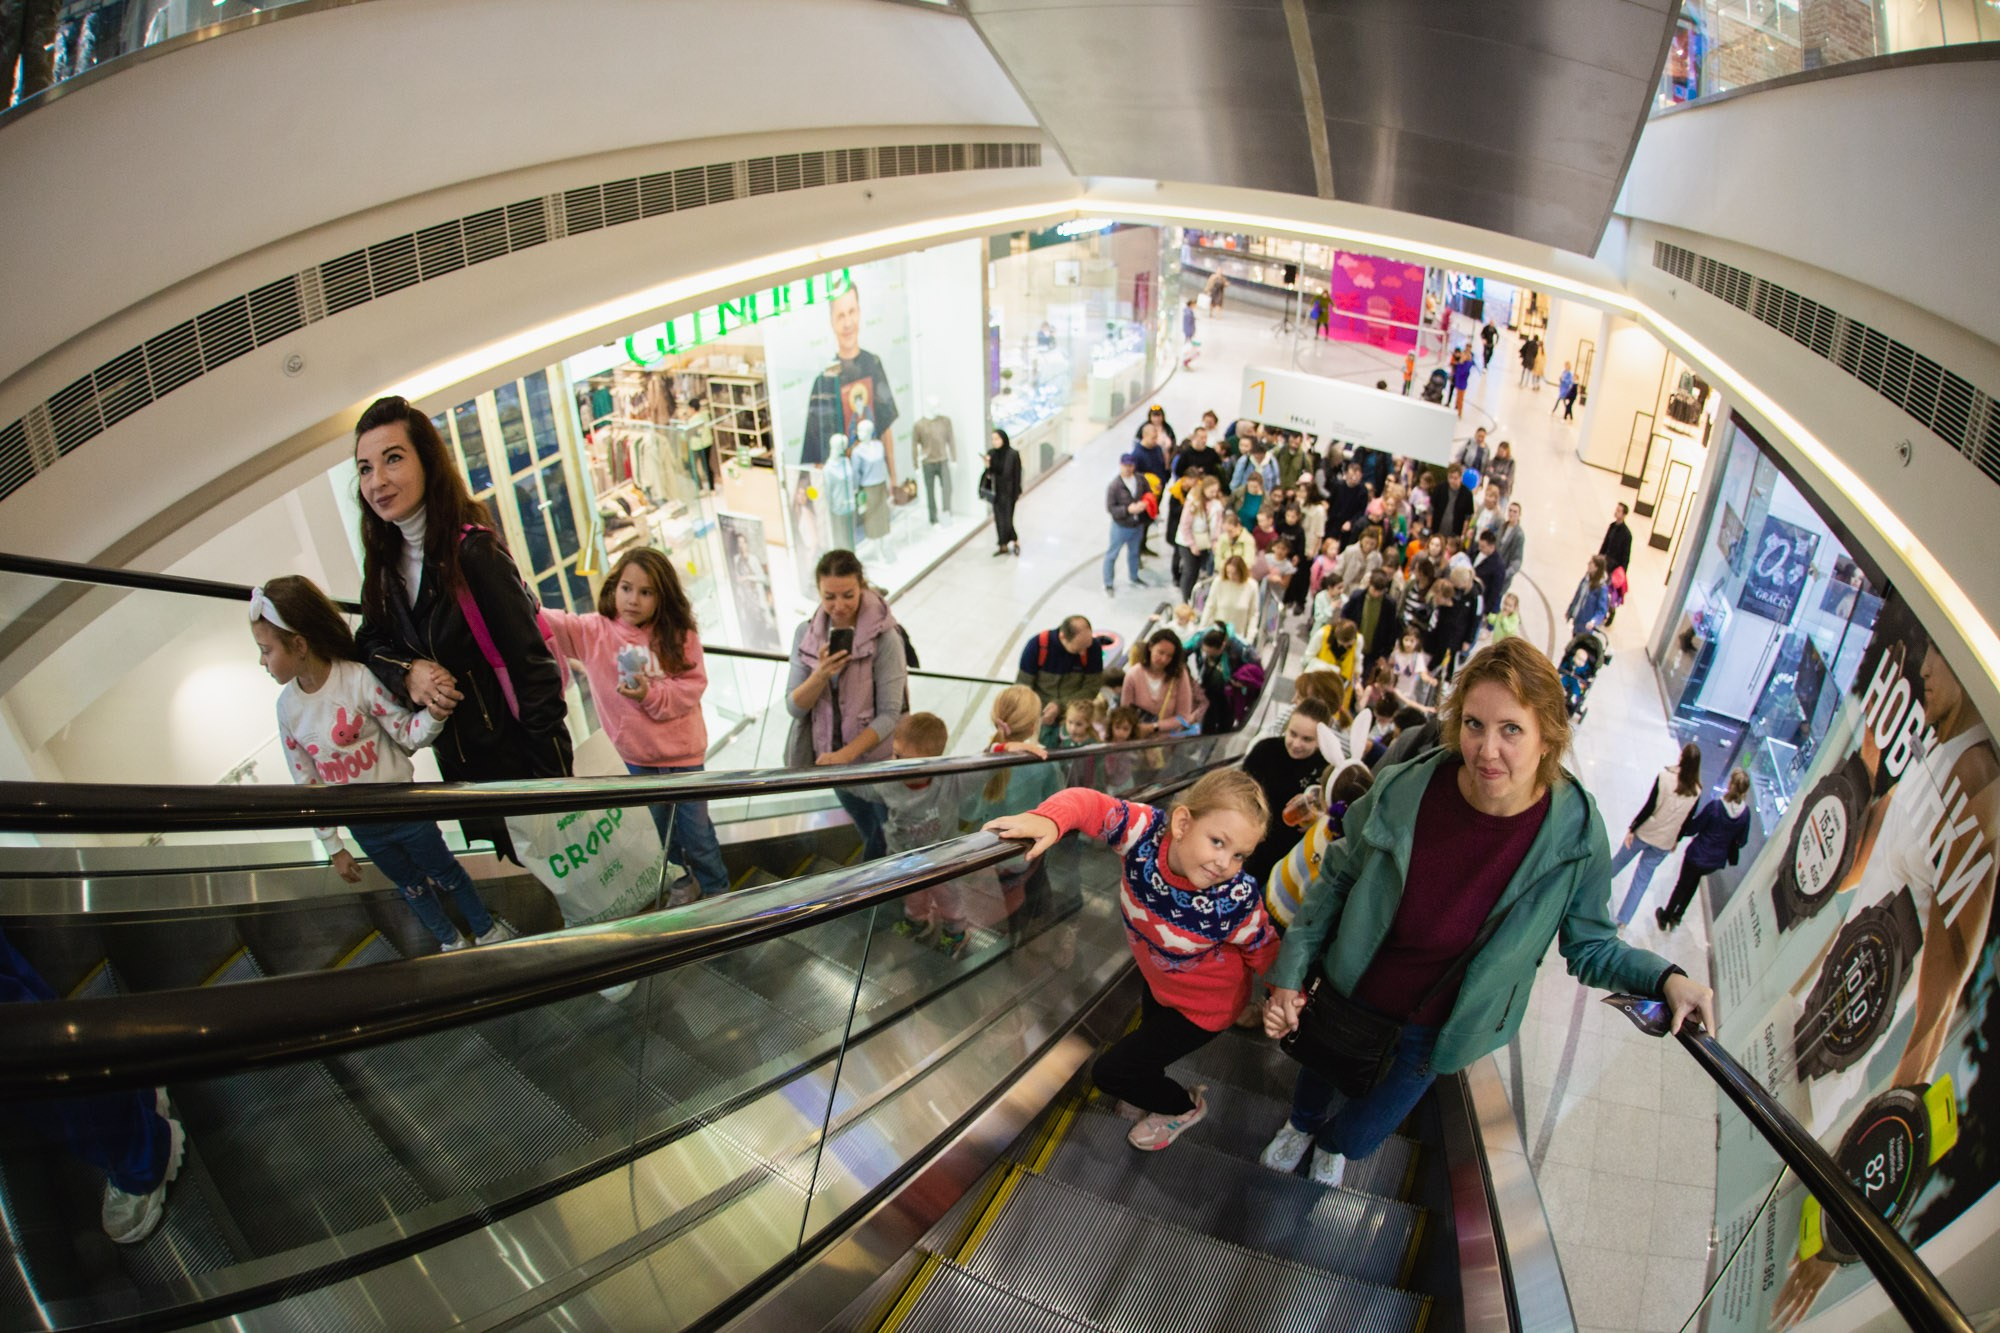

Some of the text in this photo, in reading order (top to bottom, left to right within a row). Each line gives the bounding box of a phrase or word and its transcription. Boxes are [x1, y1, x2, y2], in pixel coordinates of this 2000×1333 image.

[1250, 380, 1266, 415] 1
[316, 740, 379, 784] onjour
[549, 808, 622, 878] CROPP
[1865, 1153, 1885, 1198] 82
[1762, 1263, 1775, 1292] 965
